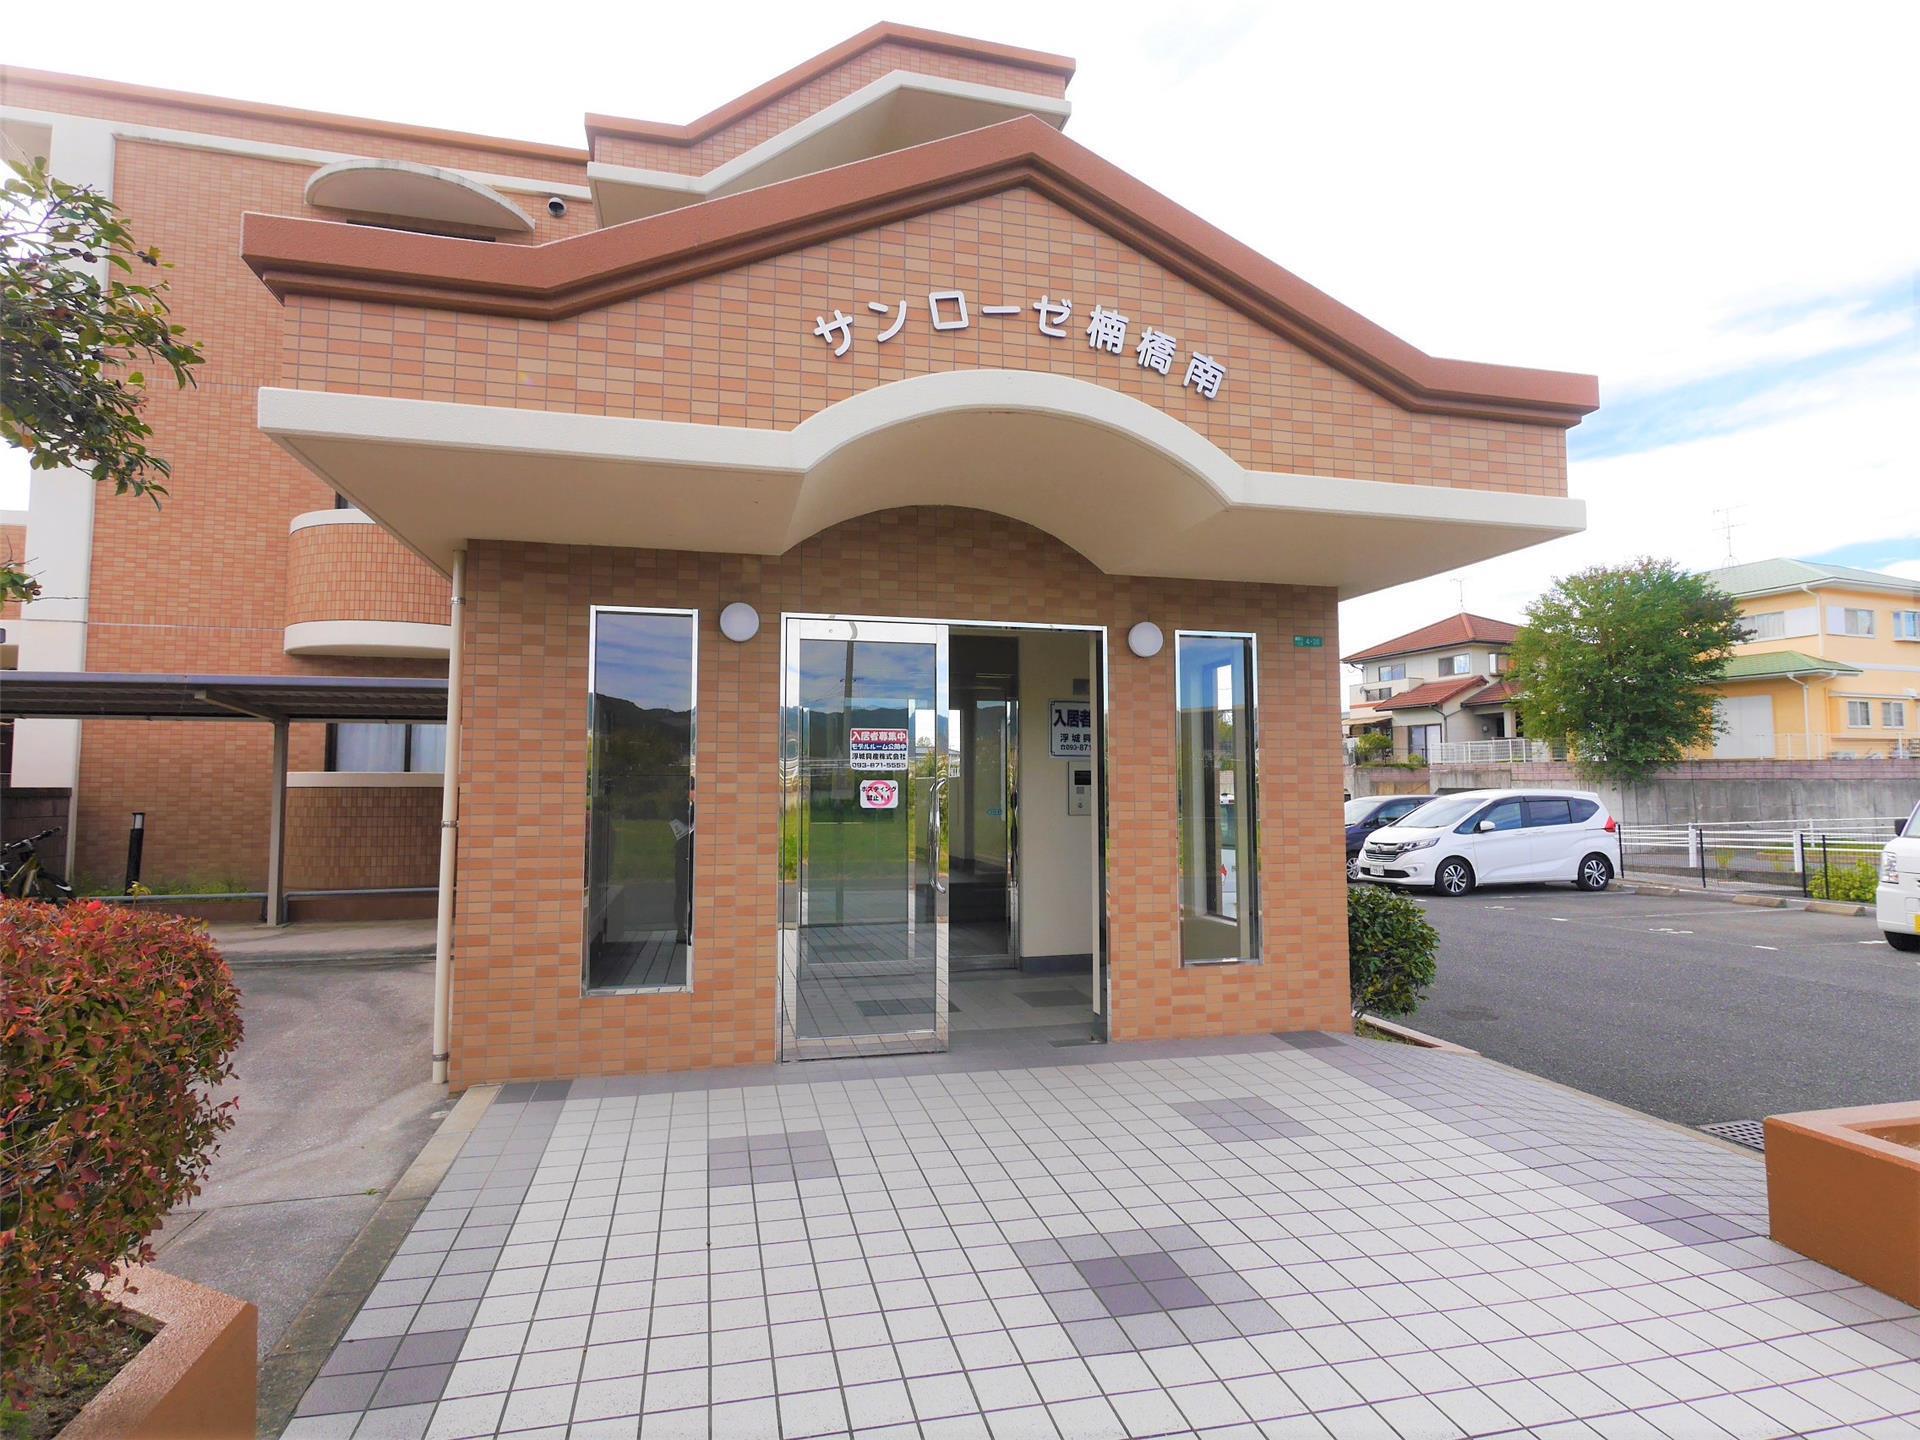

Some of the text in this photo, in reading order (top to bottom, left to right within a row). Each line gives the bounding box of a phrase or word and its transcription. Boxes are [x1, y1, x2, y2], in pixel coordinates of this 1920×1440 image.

[813, 290, 1227, 400] サンローゼ楠橋南
[852, 731, 906, 741] 入居者募集中
